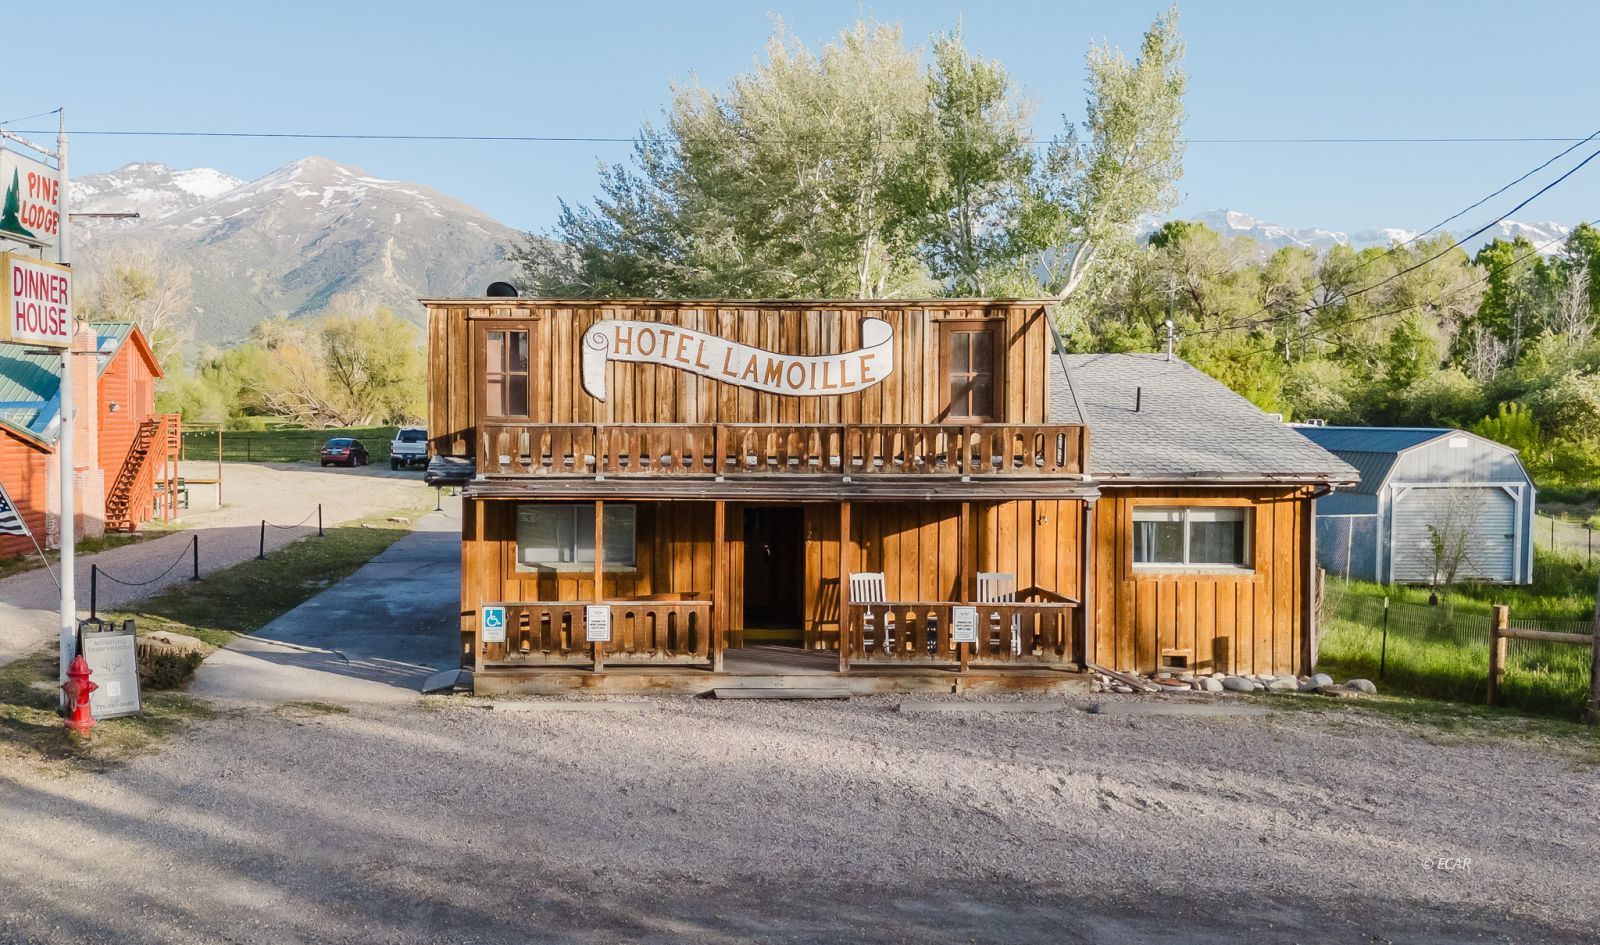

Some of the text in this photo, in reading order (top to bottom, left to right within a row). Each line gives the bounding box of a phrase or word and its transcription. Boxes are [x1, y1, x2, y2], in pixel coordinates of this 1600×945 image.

[28, 171, 58, 205] PINE
[21, 200, 59, 235] LODGE
[13, 266, 68, 305] DINNER
[16, 301, 67, 336] HOUSE
[614, 325, 876, 390] HOTEL LAMOILLE
